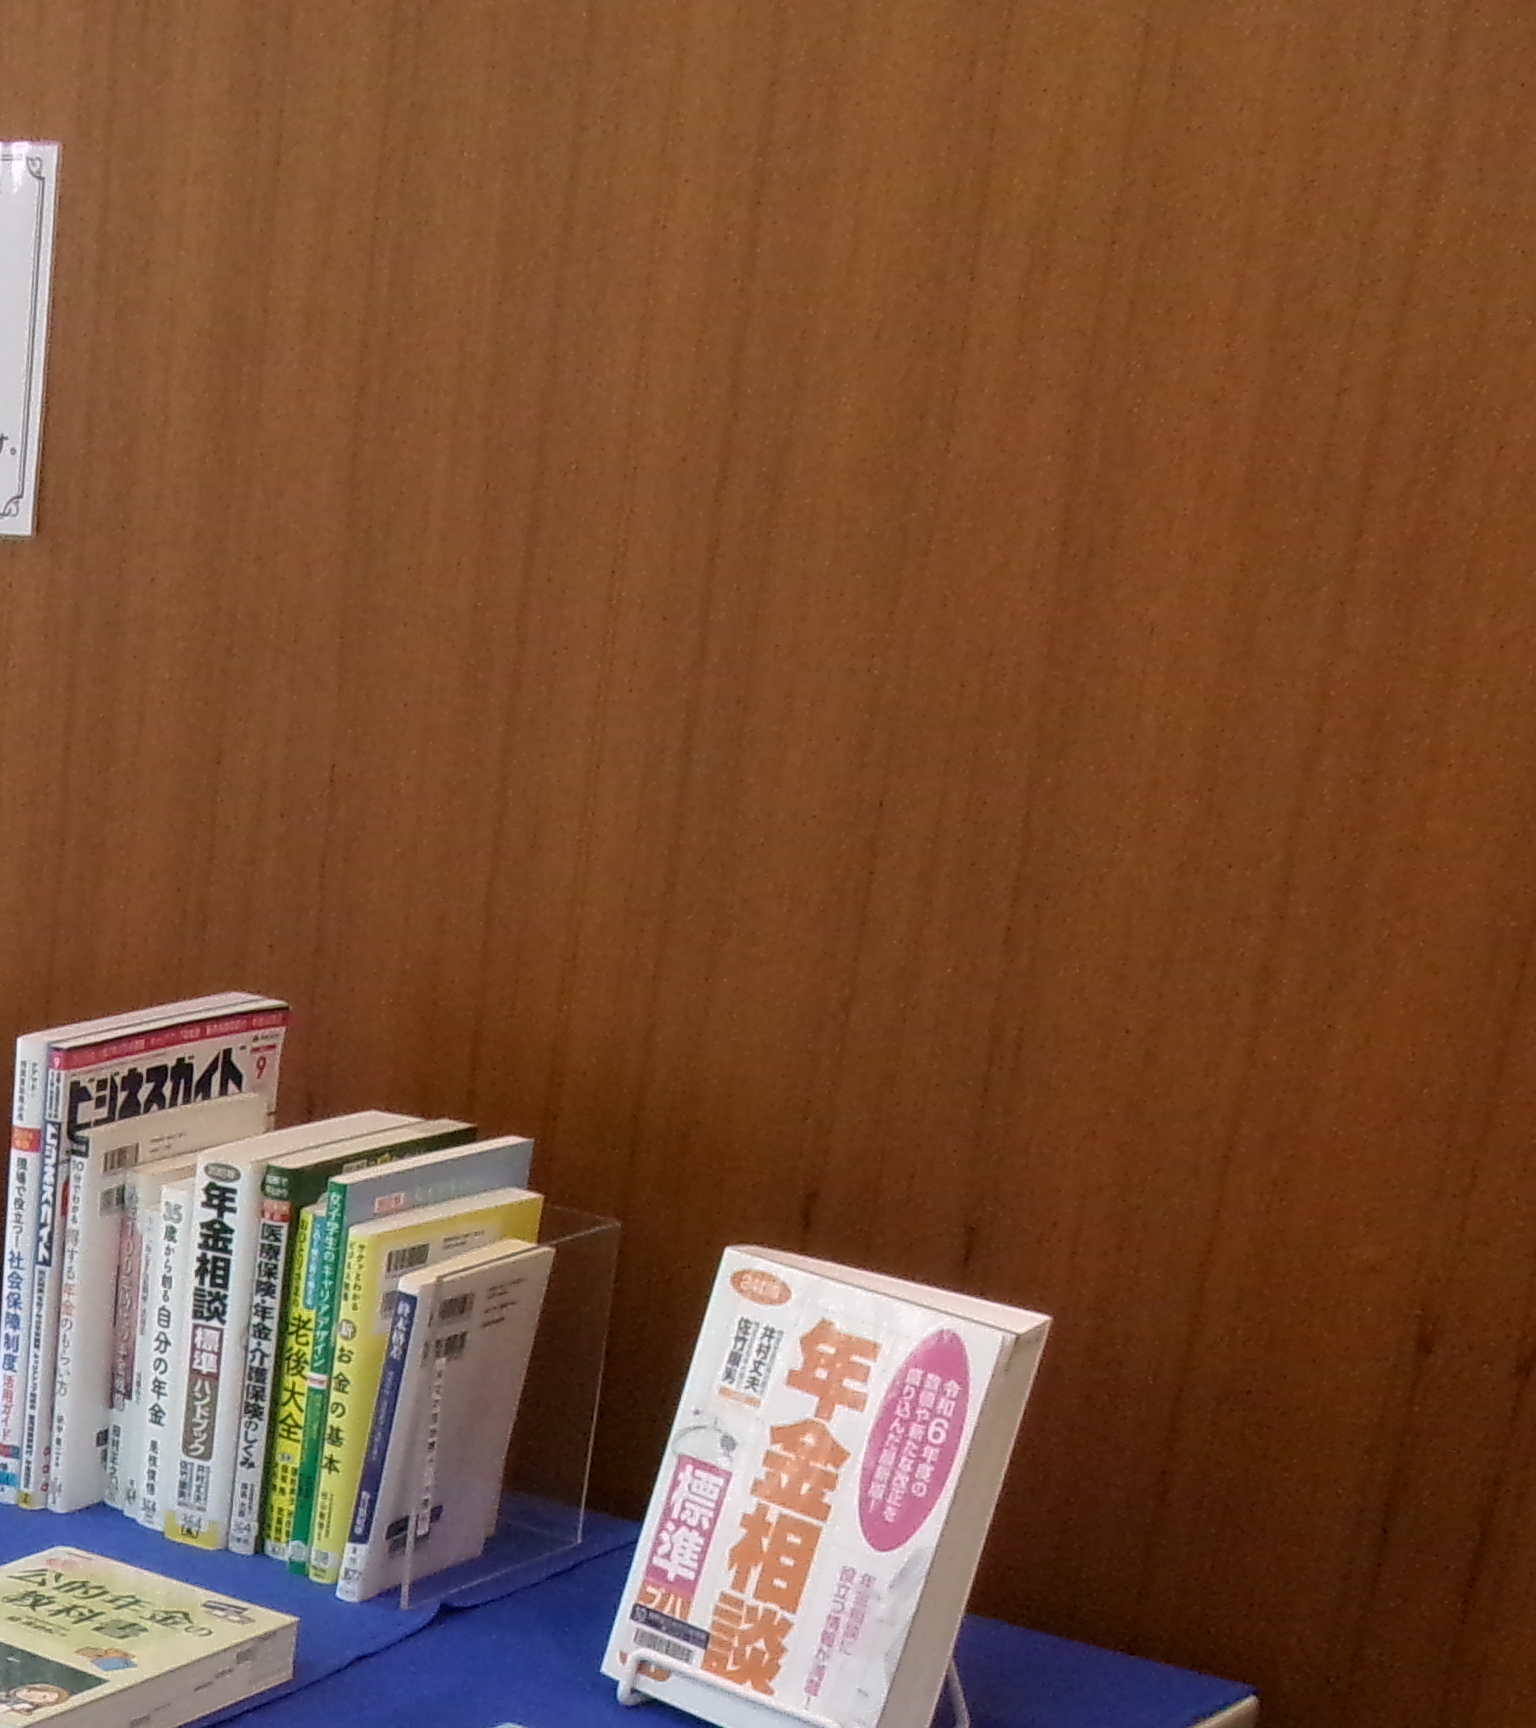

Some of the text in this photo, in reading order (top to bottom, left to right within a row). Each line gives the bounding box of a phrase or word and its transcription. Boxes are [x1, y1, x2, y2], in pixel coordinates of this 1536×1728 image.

[254, 1056, 267, 1080] 9
[1, 1249, 26, 1373] 社会保障制度
[192, 1182, 239, 1326] 年金相談
[192, 1327, 222, 1376] 標準
[279, 1314, 314, 1444] 老後大全
[324, 1346, 355, 1475] お金の基本
[188, 1380, 212, 1457] ハンドブック
[653, 1464, 726, 1584] 標準
[700, 1318, 882, 1697] 年金相談
[5, 1566, 216, 1638] 公的年金の
